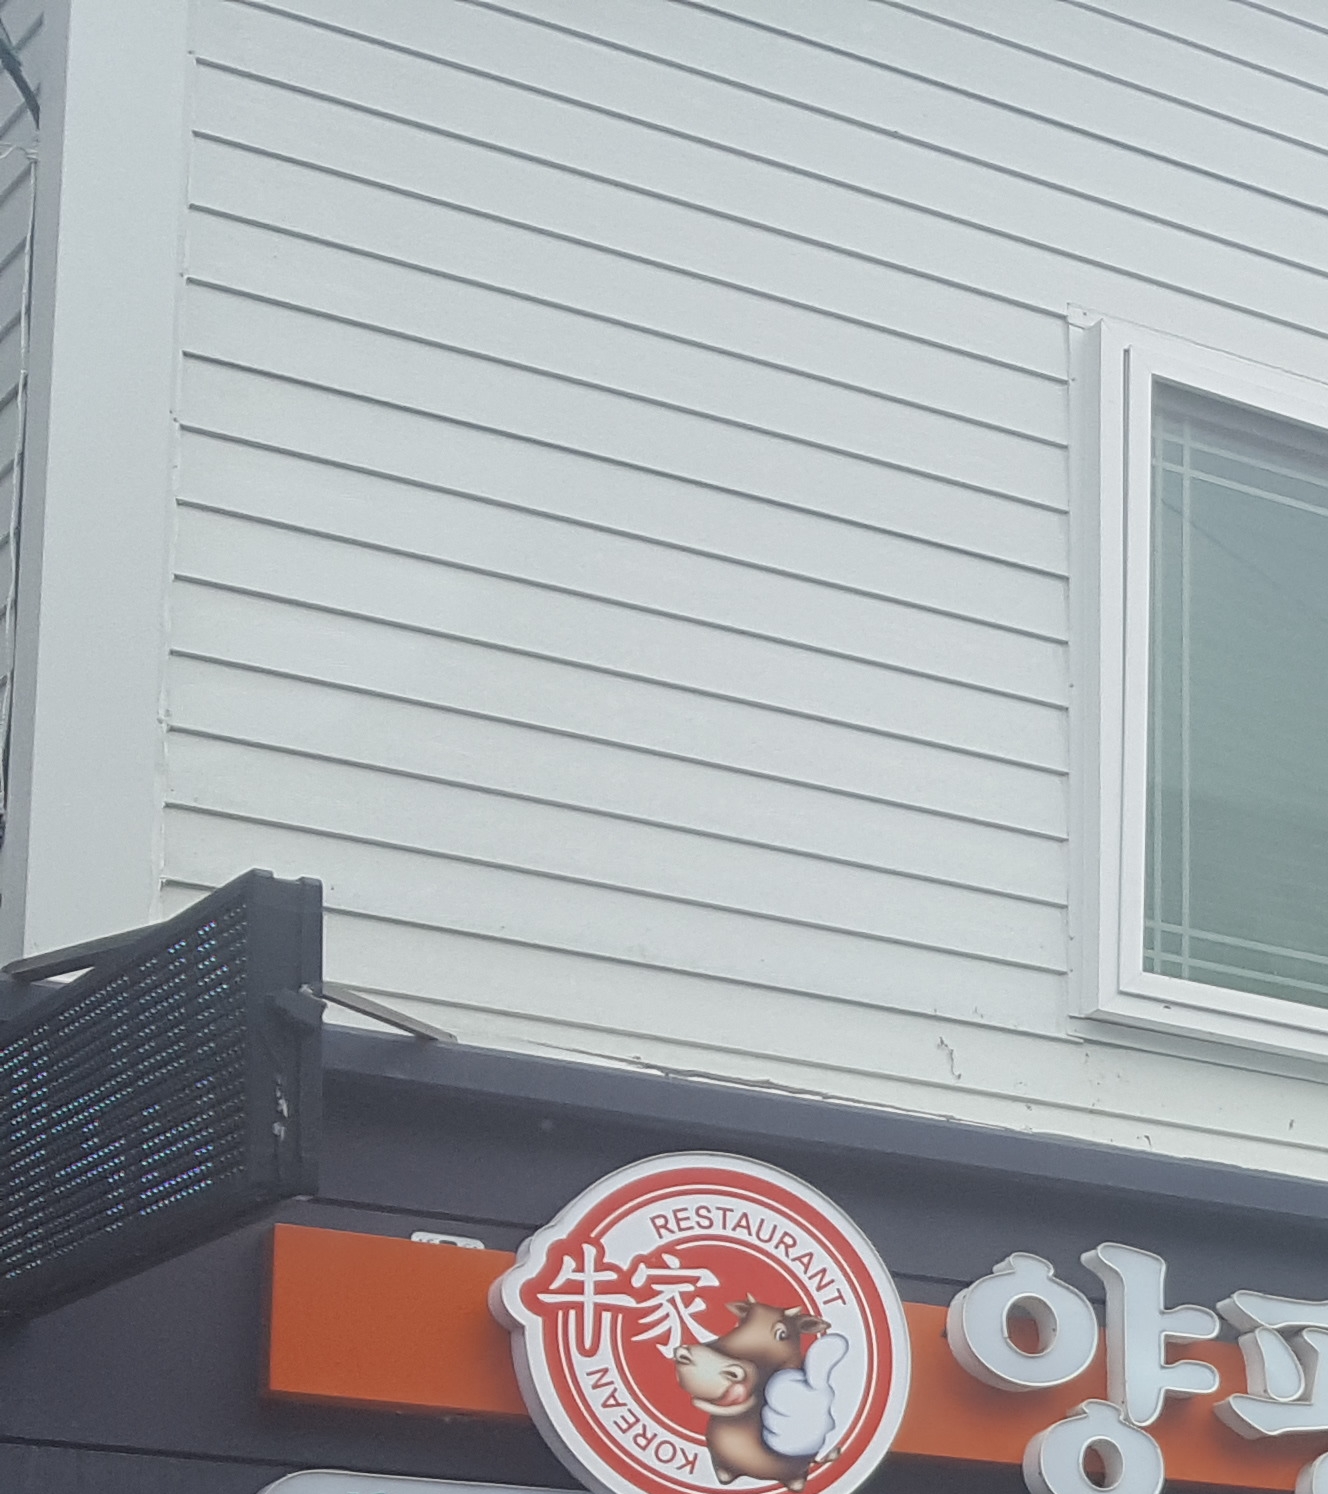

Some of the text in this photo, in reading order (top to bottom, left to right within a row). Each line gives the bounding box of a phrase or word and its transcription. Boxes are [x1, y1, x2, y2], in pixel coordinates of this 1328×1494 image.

[536, 1244, 721, 1358] 牛家
[649, 1205, 848, 1310] RESTAURANT
[586, 1365, 700, 1475] KOREAN
